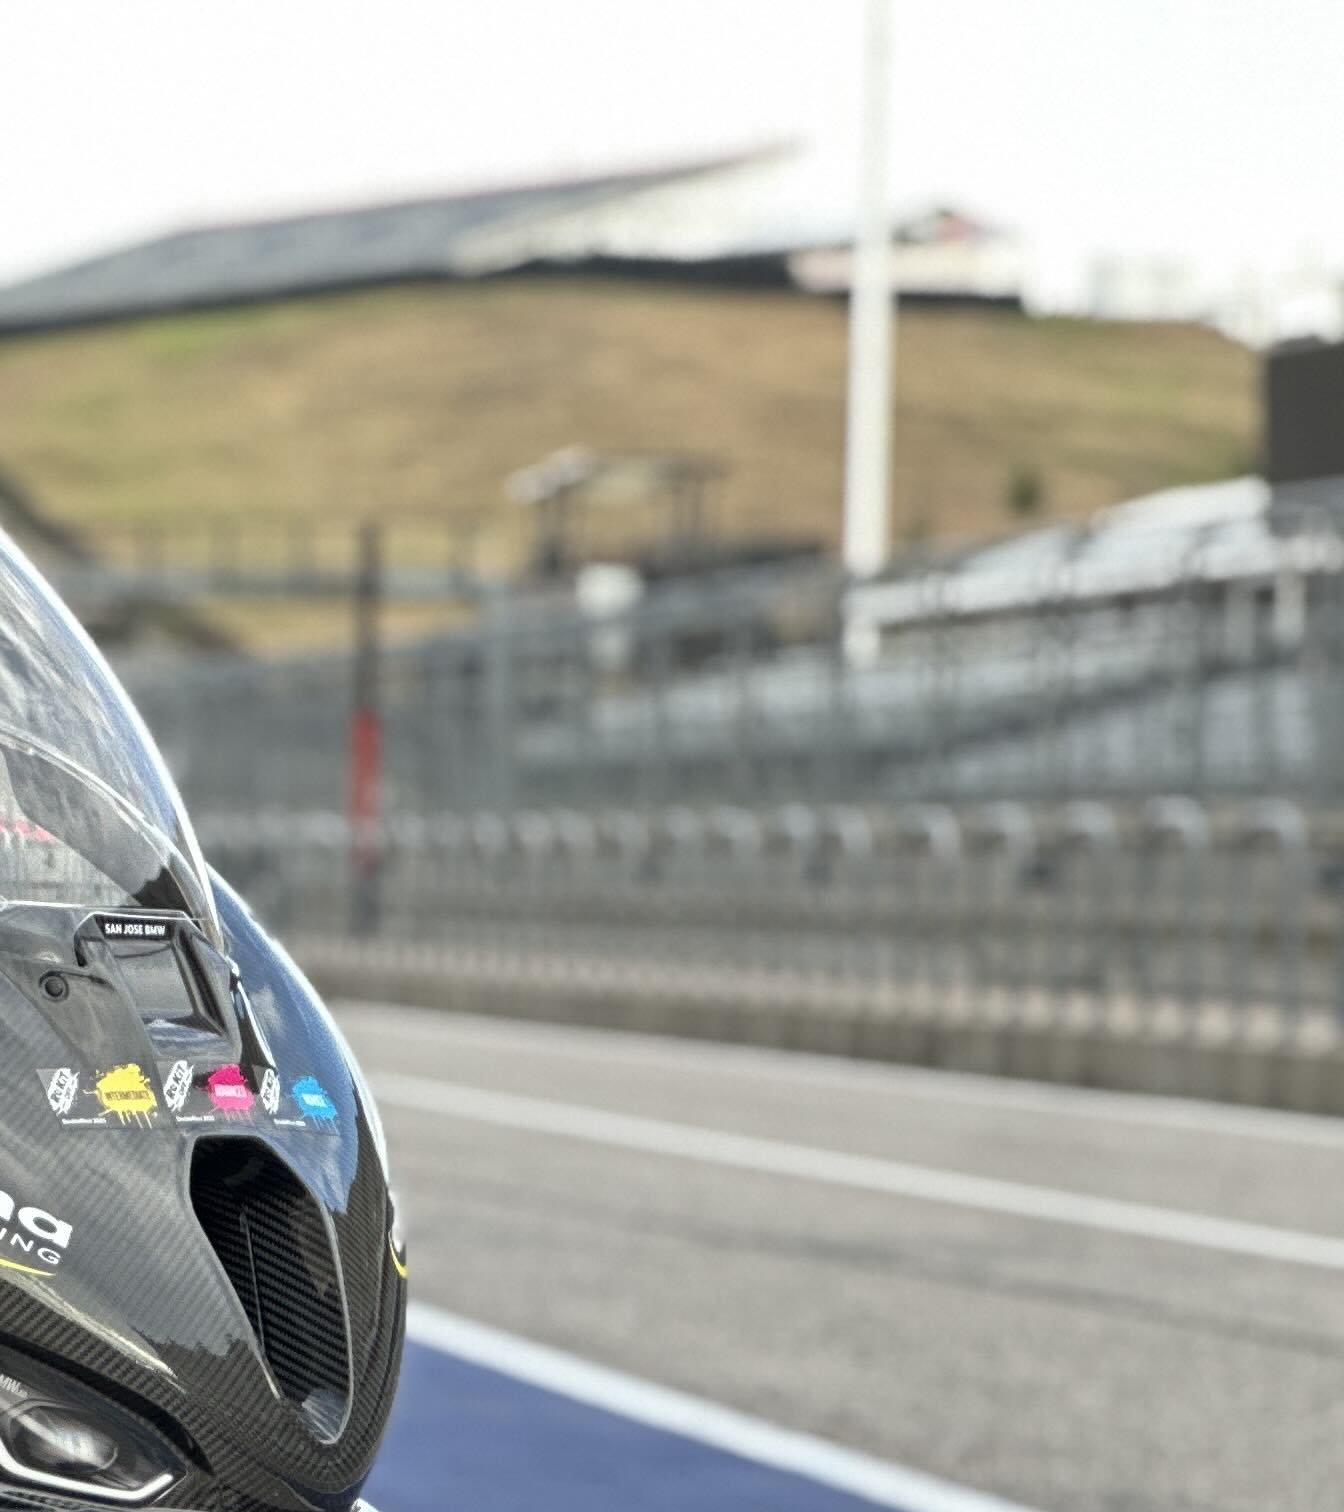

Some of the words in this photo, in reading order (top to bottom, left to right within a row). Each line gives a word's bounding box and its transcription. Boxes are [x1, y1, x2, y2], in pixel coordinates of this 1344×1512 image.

[104, 922, 123, 934] SAN
[123, 923, 144, 935] JOSE
[144, 924, 166, 936] BMW
